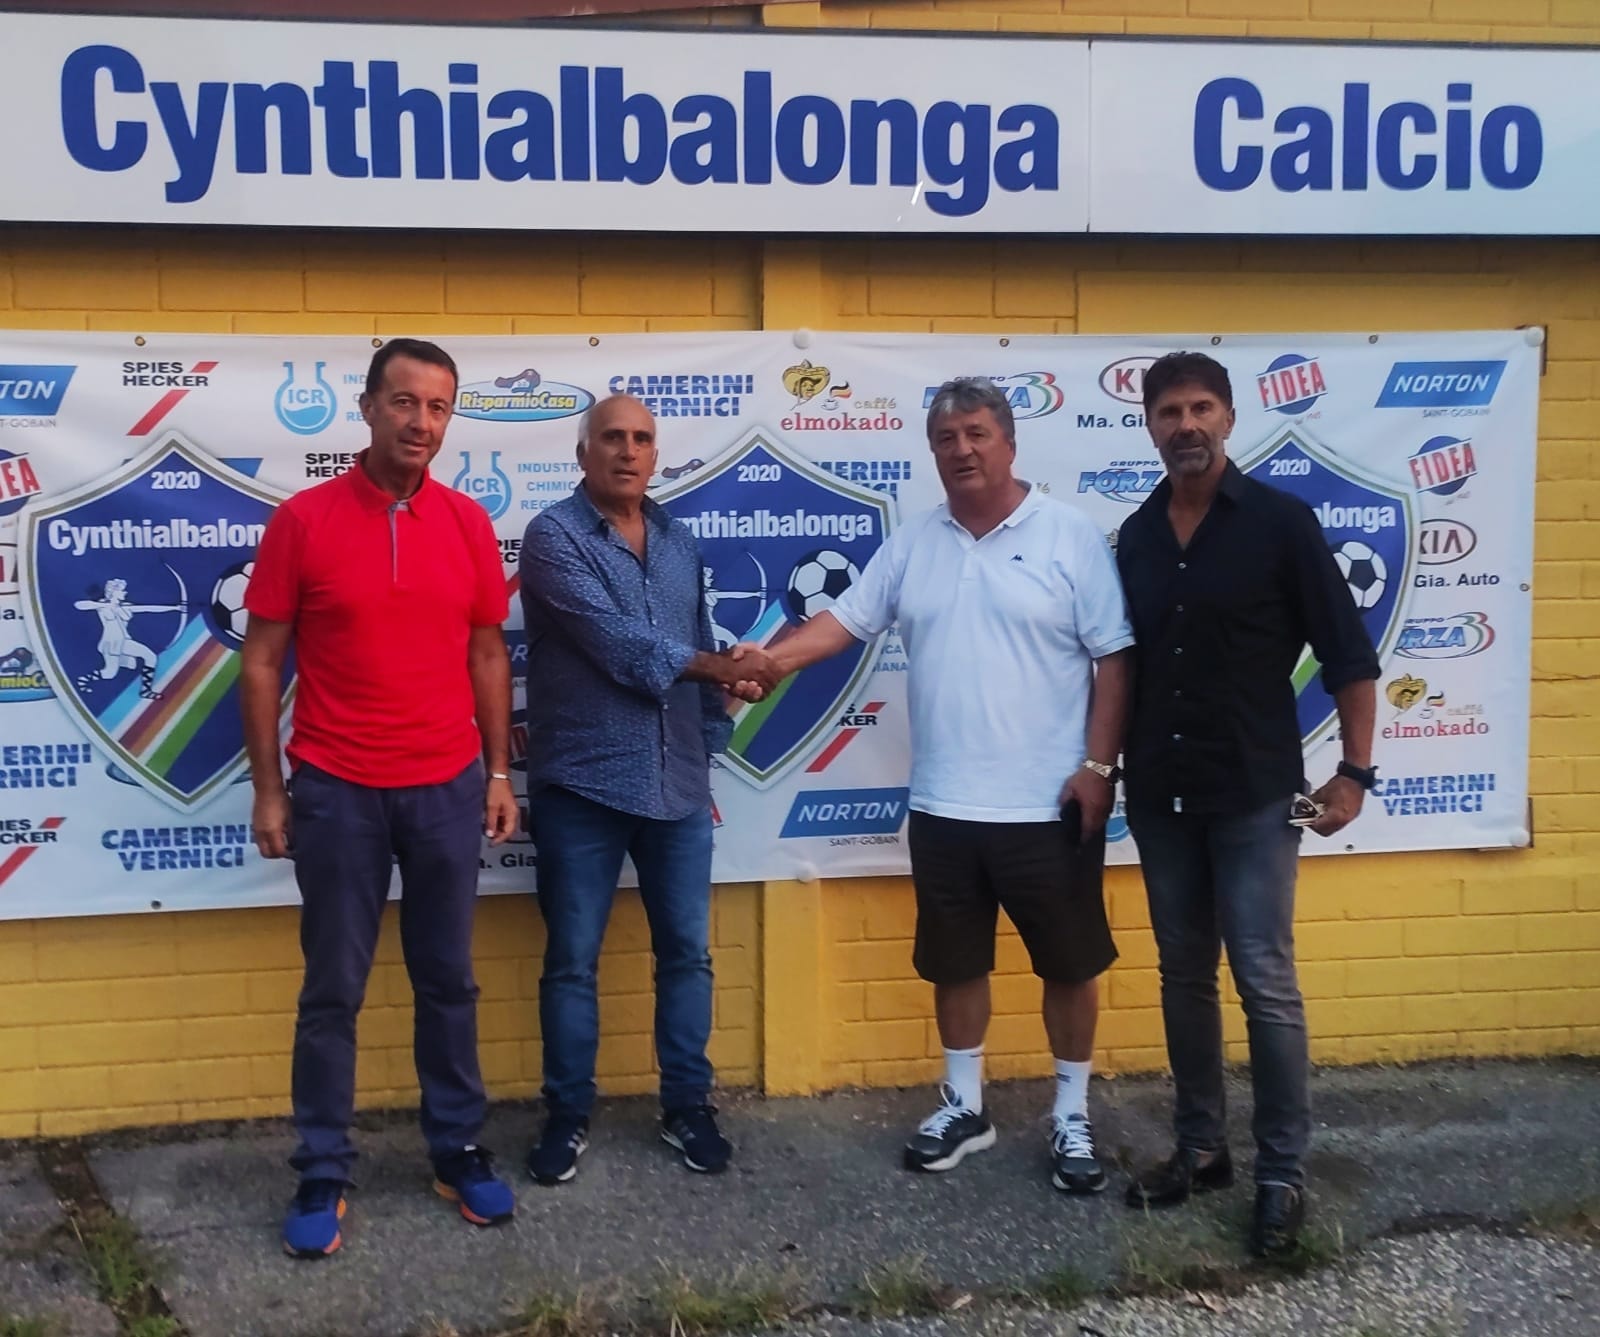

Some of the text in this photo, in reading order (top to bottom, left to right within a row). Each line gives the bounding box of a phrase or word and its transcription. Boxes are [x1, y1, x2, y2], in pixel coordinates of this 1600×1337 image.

[60, 44, 1543, 217] Cynthialbalonga Calcio
[123, 361, 183, 373] SPIES
[123, 375, 209, 387] HECKER
[608, 374, 754, 396] CAMERINI
[1257, 361, 1327, 409] FIDEA
[1393, 373, 1490, 394] NORTON
[288, 389, 326, 404] ICR
[460, 391, 577, 411] RisparmioCasa
[637, 396, 740, 417] ERNICI
[780, 412, 903, 431] elmokado
[1077, 415, 1114, 429] Ma.
[737, 464, 782, 482] 2020
[1270, 459, 1311, 477] 2020
[1408, 442, 1477, 490] FIDEA
[151, 471, 201, 490] 2020
[465, 478, 500, 493] ICR
[1457, 572, 1501, 587] Auto
[1382, 718, 1489, 739] elmokado
[798, 801, 900, 822] NORTON
[1383, 794, 1483, 817] VERNICI
[118, 846, 245, 872] VERNICI
